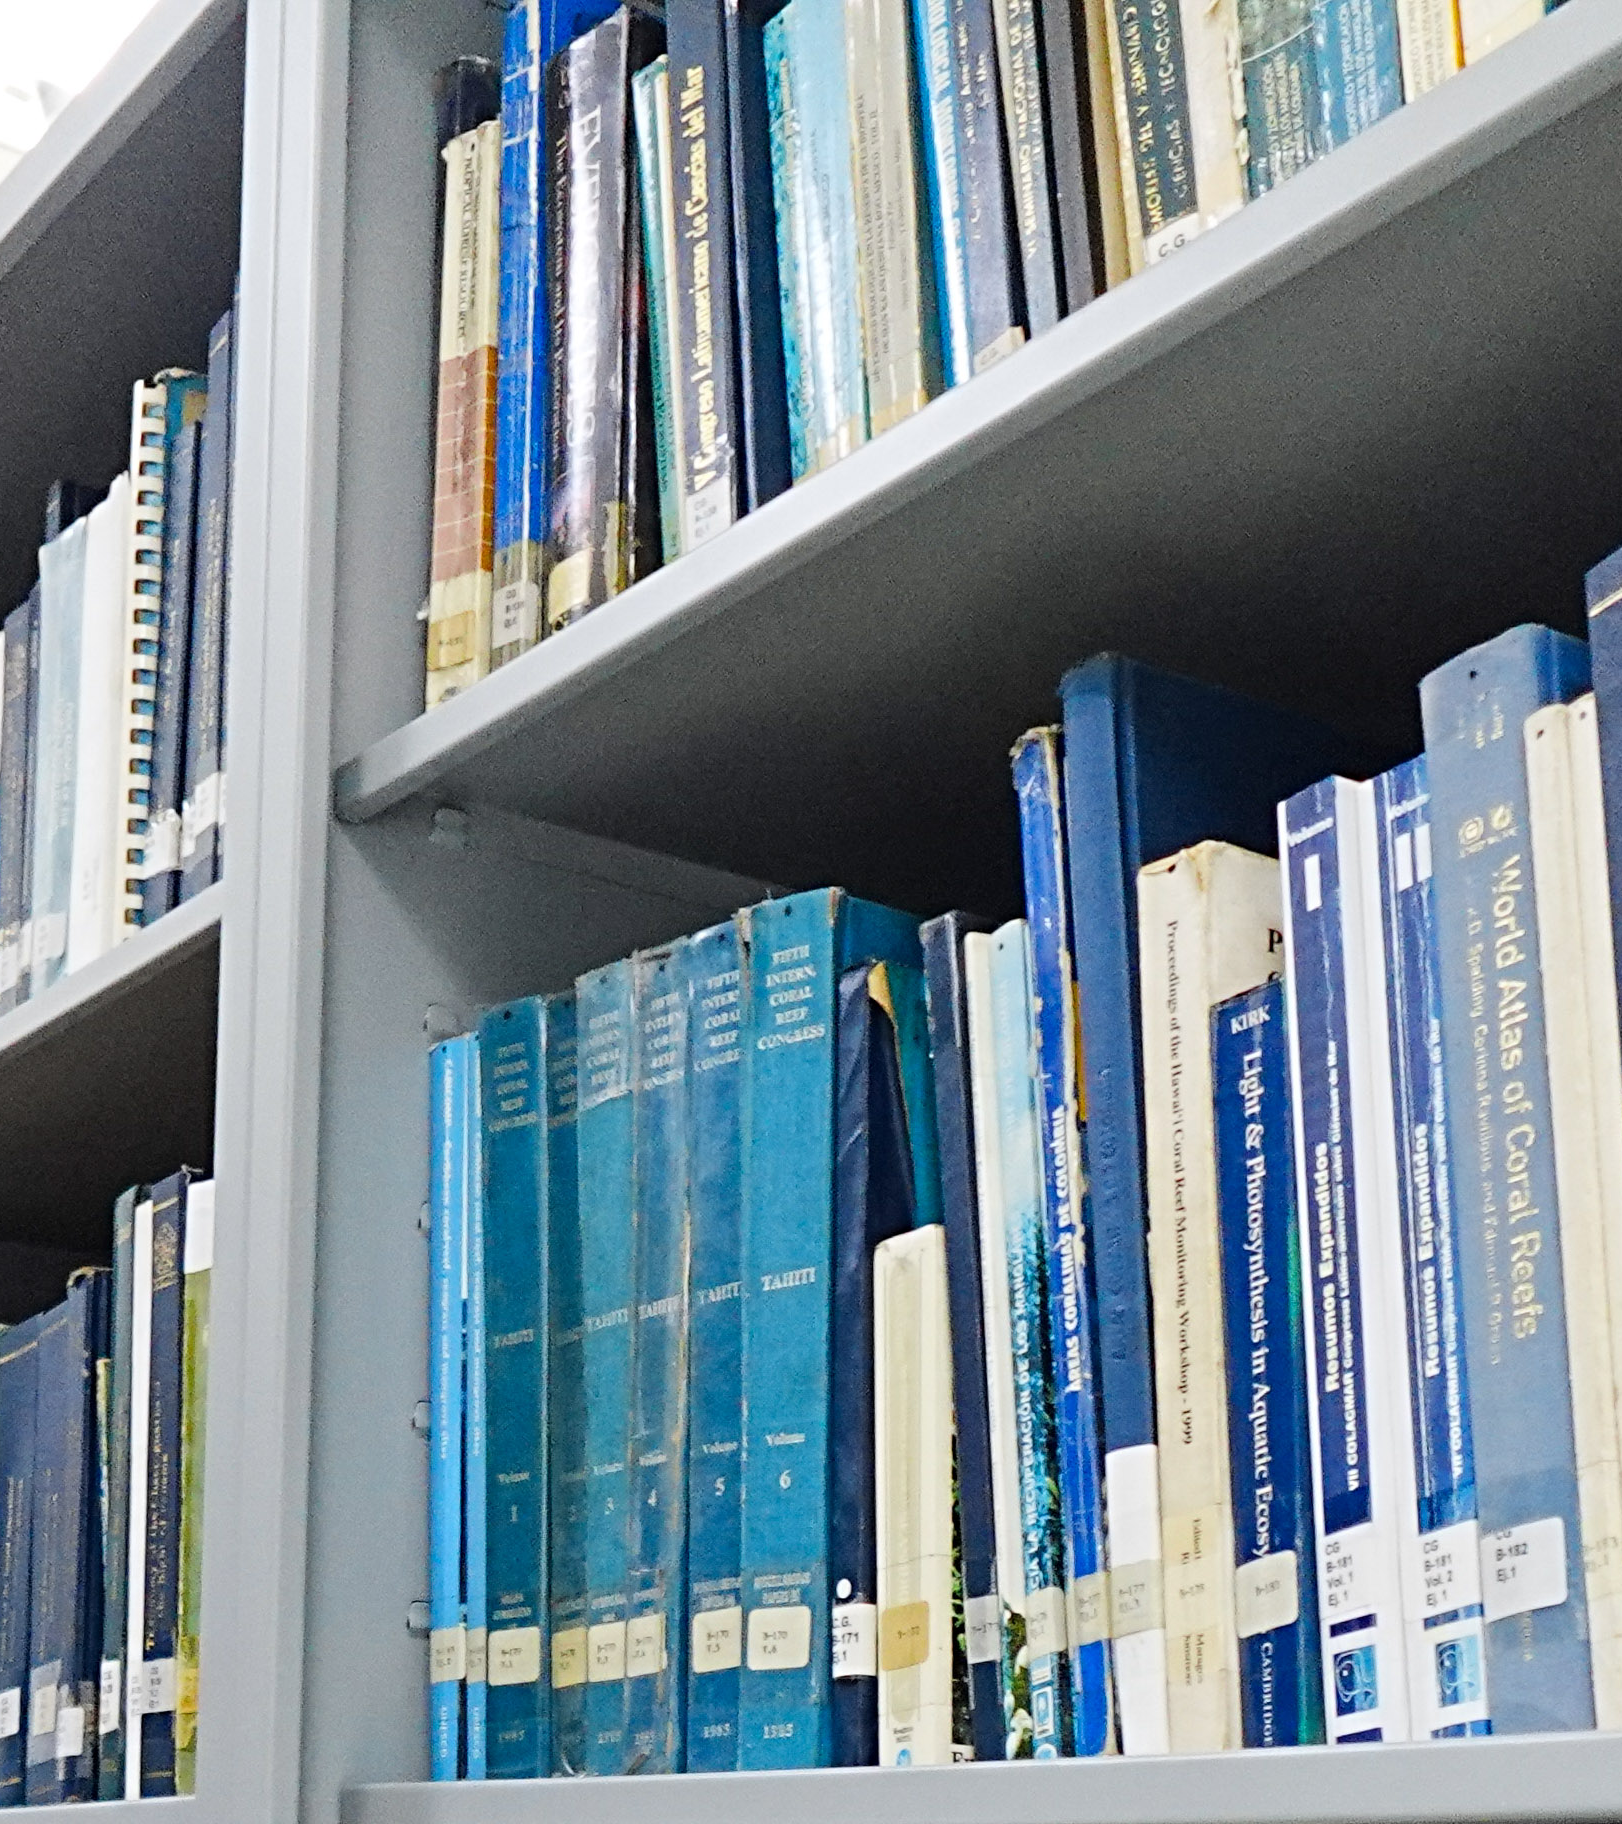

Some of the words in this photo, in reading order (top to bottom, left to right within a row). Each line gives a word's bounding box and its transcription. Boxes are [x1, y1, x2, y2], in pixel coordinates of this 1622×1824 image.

[1008, 23, 1024, 45] DE
[679, 65, 706, 107] Mar
[1011, 50, 1031, 138] NACIONAL
[681, 108, 708, 138] del
[1137, 122, 1155, 152] DEL
[683, 141, 709, 216] Ciencias
[1017, 143, 1038, 236] SEMINARIO
[683, 215, 709, 239] de
[691, 381, 716, 471] Congreso
[693, 476, 717, 491] V
[1491, 854, 1528, 969] World
[771, 945, 810, 966] FIFTH
[769, 984, 814, 1007] CORAL
[703, 1008, 741, 1030] CORAL
[775, 1006, 809, 1026] REEF
[1229, 1007, 1272, 1034] KIRK
[1497, 978, 1529, 1071] Atlas
[709, 1029, 739, 1048] REEF
[757, 1023, 826, 1051] CONGRESS
[1239, 1050, 1265, 1115] Light
[1502, 1081, 1534, 1115] of
[1050, 1106, 1073, 1198] COLOMBIA
[1245, 1122, 1266, 1152] &
[1505, 1123, 1540, 1225] Coral
[1412, 1124, 1437, 1260] Expandidos
[1057, 1201, 1075, 1227] DE
[1312, 1143, 1338, 1277] Expandidos
[1241, 1156, 1271, 1343] Photosynthesis
[697, 1280, 741, 1304] TAHITI
[761, 1265, 816, 1292] TAHITI
[1058, 1235, 1080, 1331] CORALINAS
[1511, 1231, 1544, 1339] Reefs
[1420, 1267, 1442, 1377] Resumos
[1318, 1284, 1342, 1392] Resumos
[1063, 1338, 1082, 1393] ÁREAS
[1250, 1347, 1271, 1373] in
[765, 1432, 806, 1447] Volume
[1247, 1382, 1274, 1480] Aquatic
[702, 1442, 739, 1457] Volume
[714, 1477, 726, 1497] 5
[778, 1469, 793, 1490] 6
[1325, 1542, 1341, 1555] CG
[1422, 1539, 1439, 1554] CG
